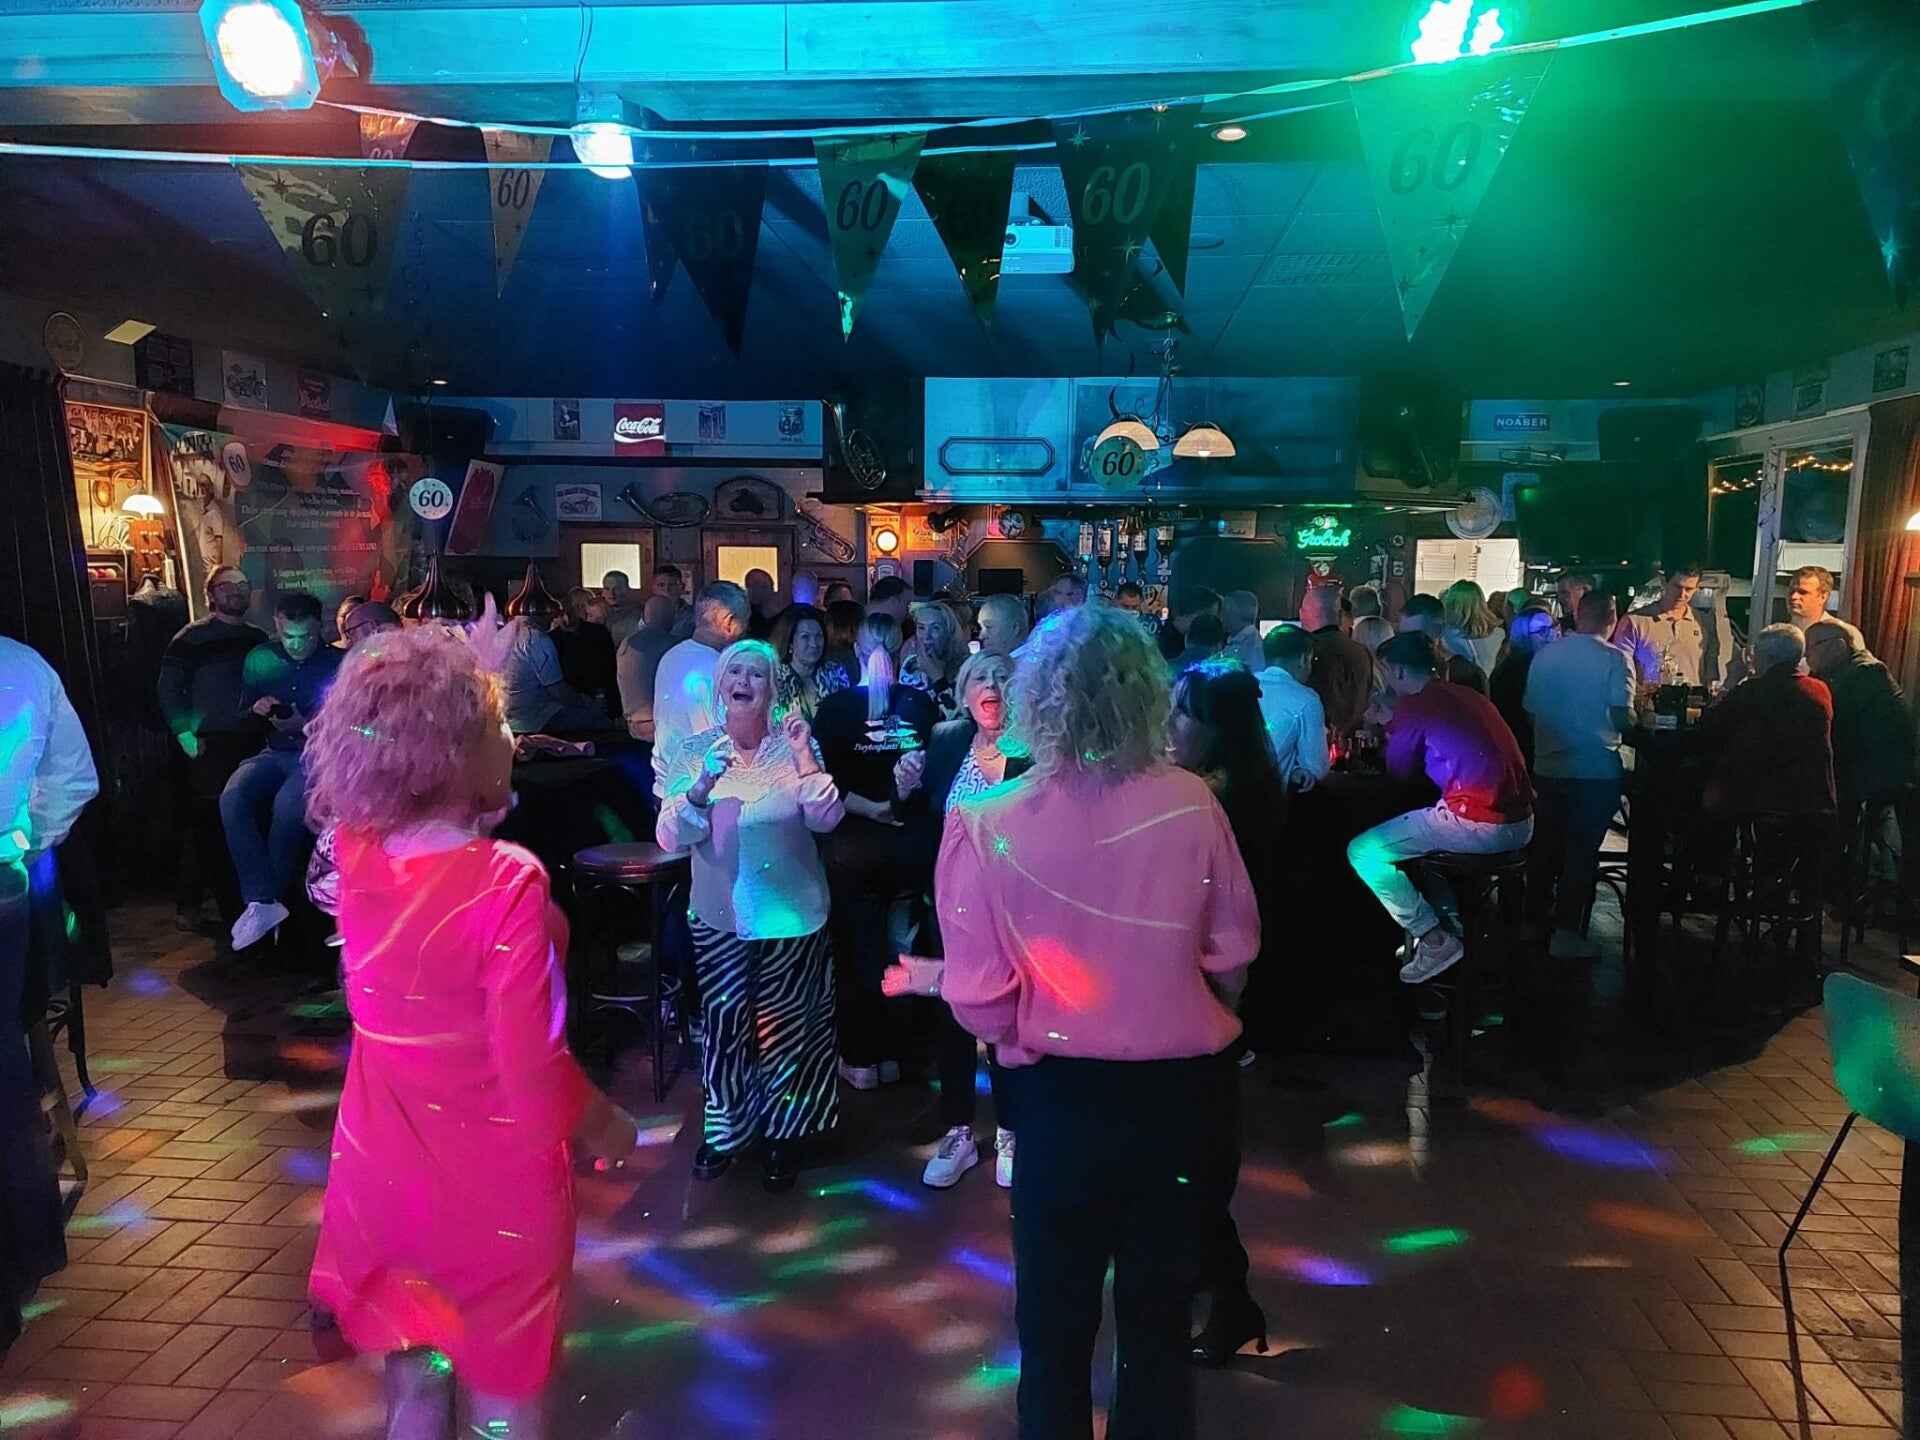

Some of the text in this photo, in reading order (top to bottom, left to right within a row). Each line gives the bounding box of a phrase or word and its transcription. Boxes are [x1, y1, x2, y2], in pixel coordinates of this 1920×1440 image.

[1391, 121, 1481, 195] 60
[498, 168, 530, 209] 60
[1082, 162, 1150, 224] 60
[837, 180, 888, 230] 60
[302, 213, 378, 267] 60
[616, 417, 662, 434] Coca-Cola
[1496, 418, 1547, 427] NOABER
[229, 454, 245, 473] 60
[1102, 451, 1135, 476] 60
[418, 490, 444, 507] 60
[1297, 528, 1351, 549] Grolsch
